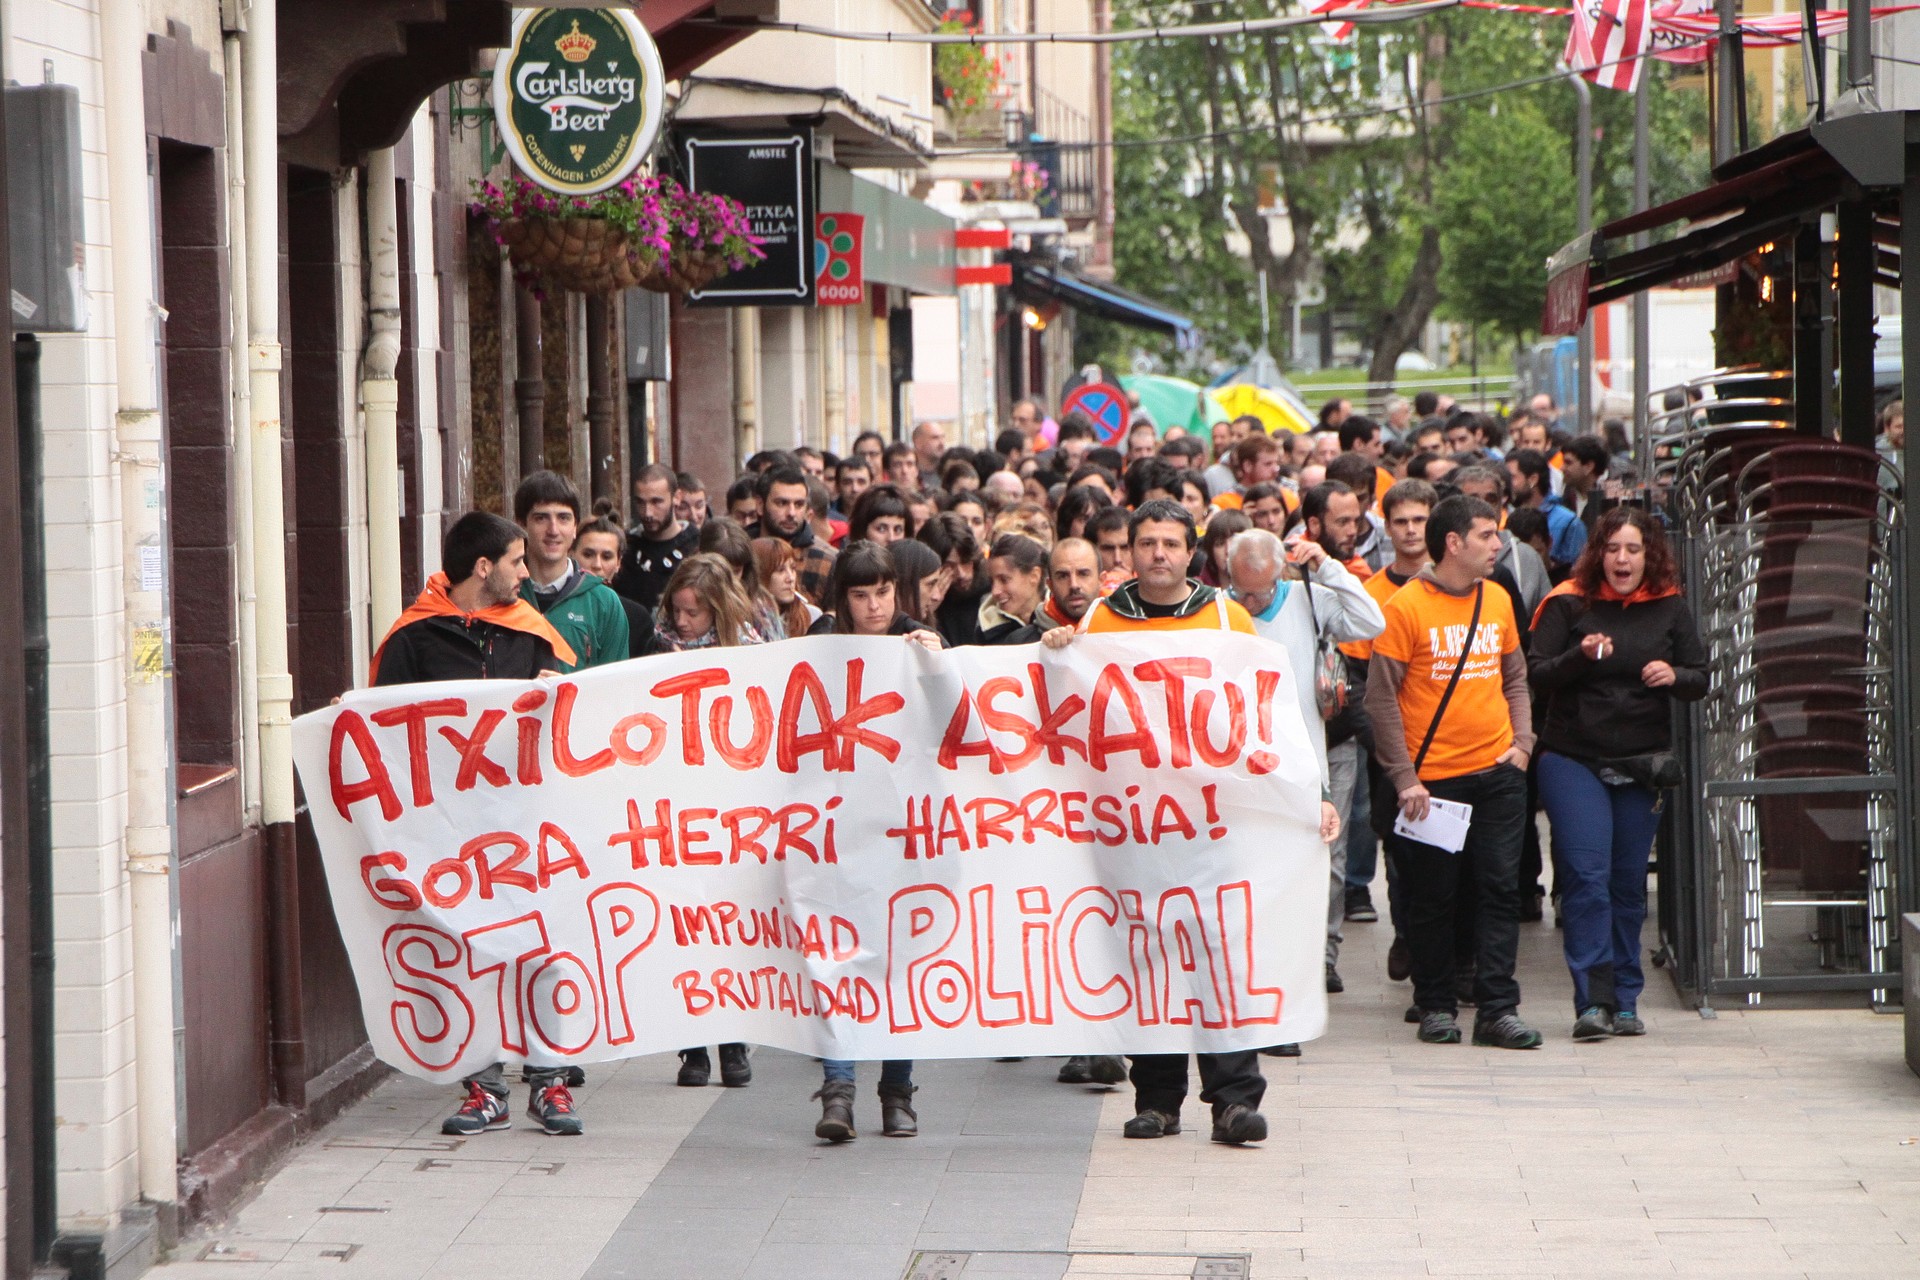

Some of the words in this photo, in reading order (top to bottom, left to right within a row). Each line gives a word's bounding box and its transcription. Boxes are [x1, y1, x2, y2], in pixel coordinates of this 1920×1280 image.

[516, 61, 635, 104] Carlsberg
[549, 106, 611, 131] Beer
[525, 134, 584, 182] COPENHAGEN
[590, 133, 629, 179] DENMARK
[748, 148, 787, 159] AMSTEL
[818, 286, 860, 299] 6000
[937, 656, 1280, 775] ASKATU!
[360, 822, 591, 911] GORA
[382, 881, 661, 1072] STOP
